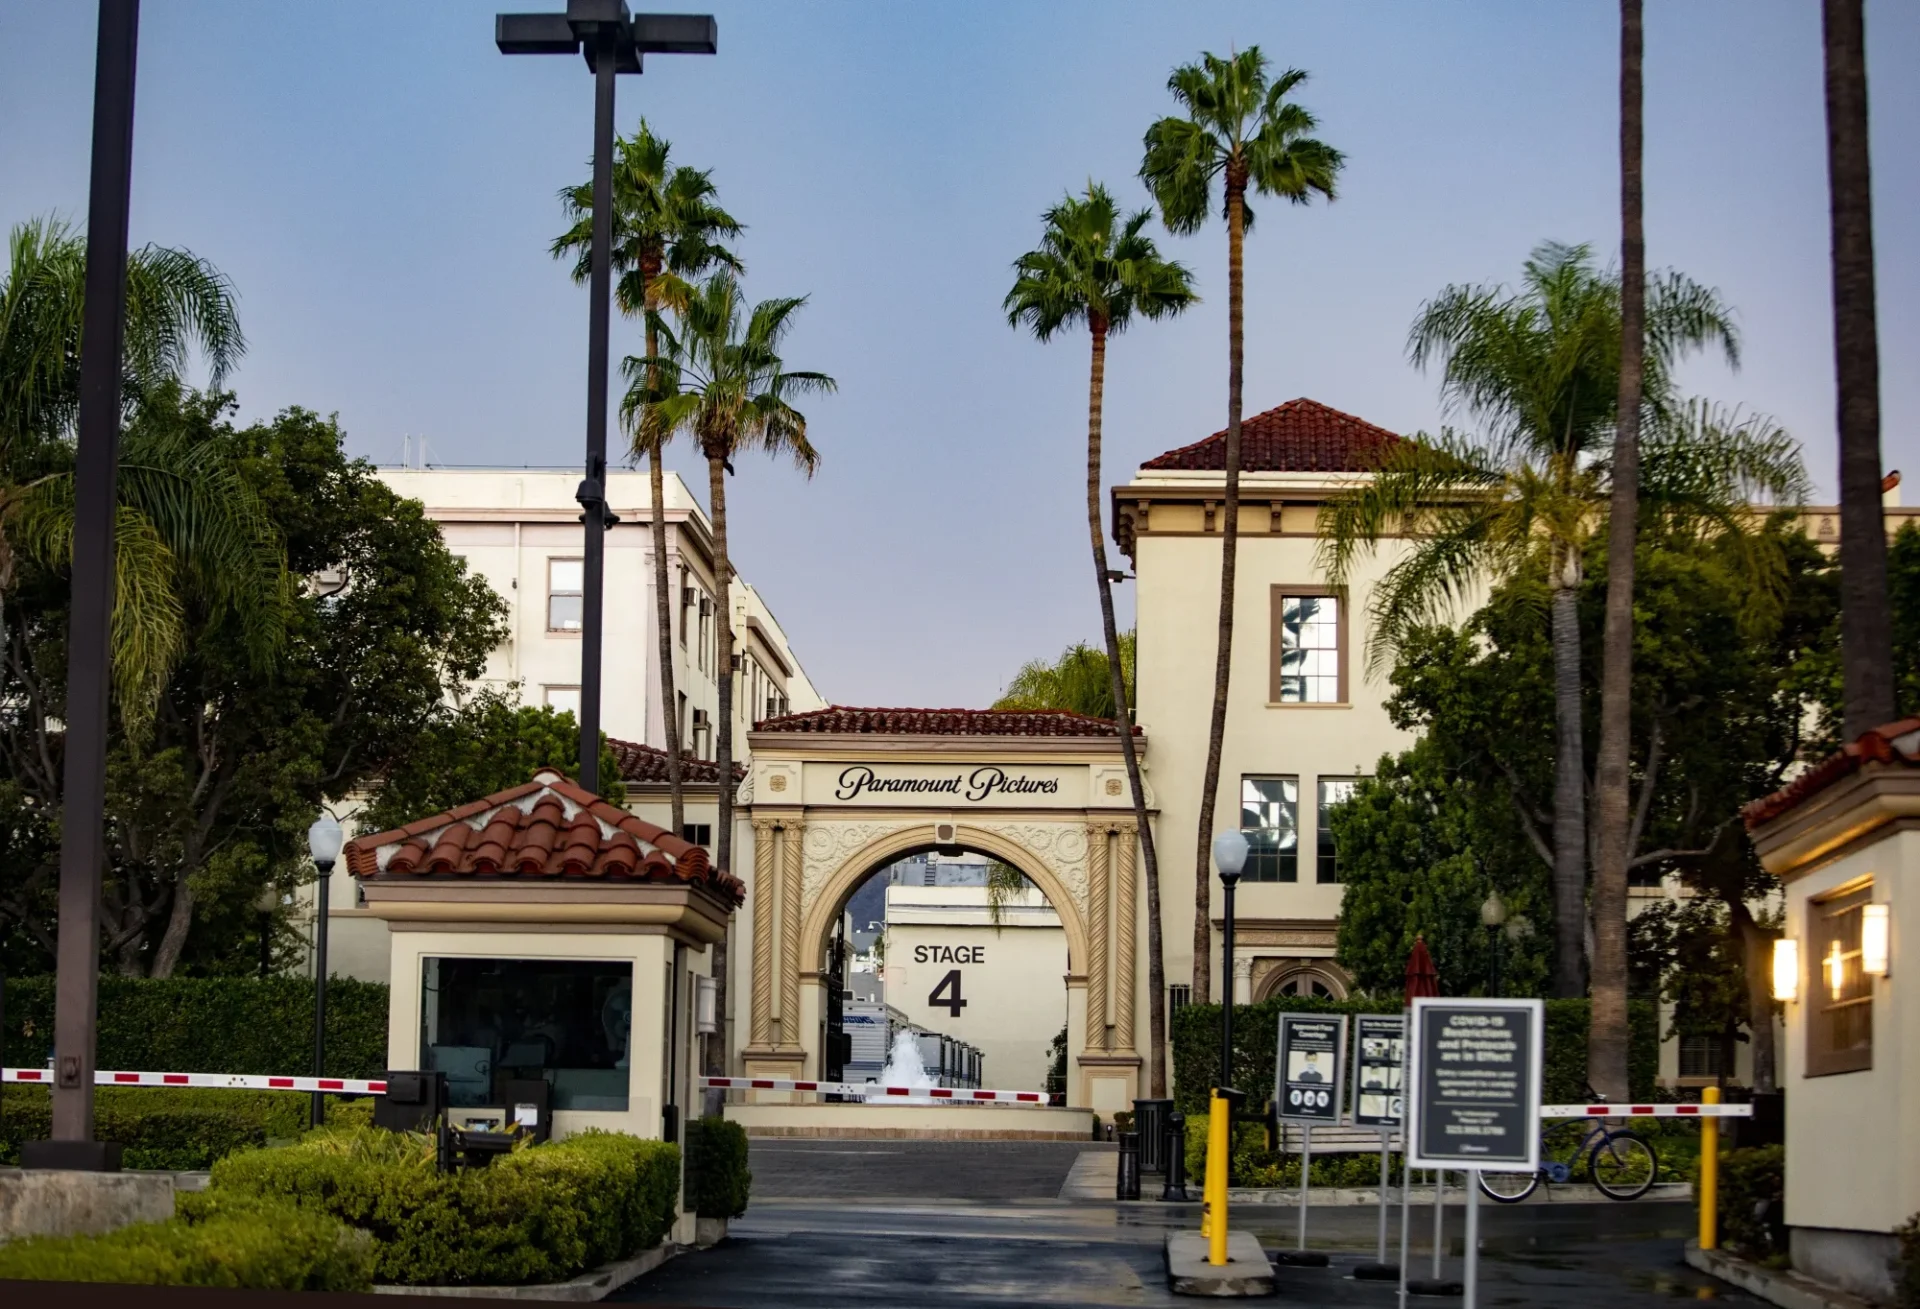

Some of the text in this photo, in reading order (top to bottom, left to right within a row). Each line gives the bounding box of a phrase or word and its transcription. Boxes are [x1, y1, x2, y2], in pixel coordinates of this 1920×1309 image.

[835, 766, 1058, 801] Paramount Pictures
[914, 945, 985, 964] STAGE
[928, 969, 968, 1018] 4
